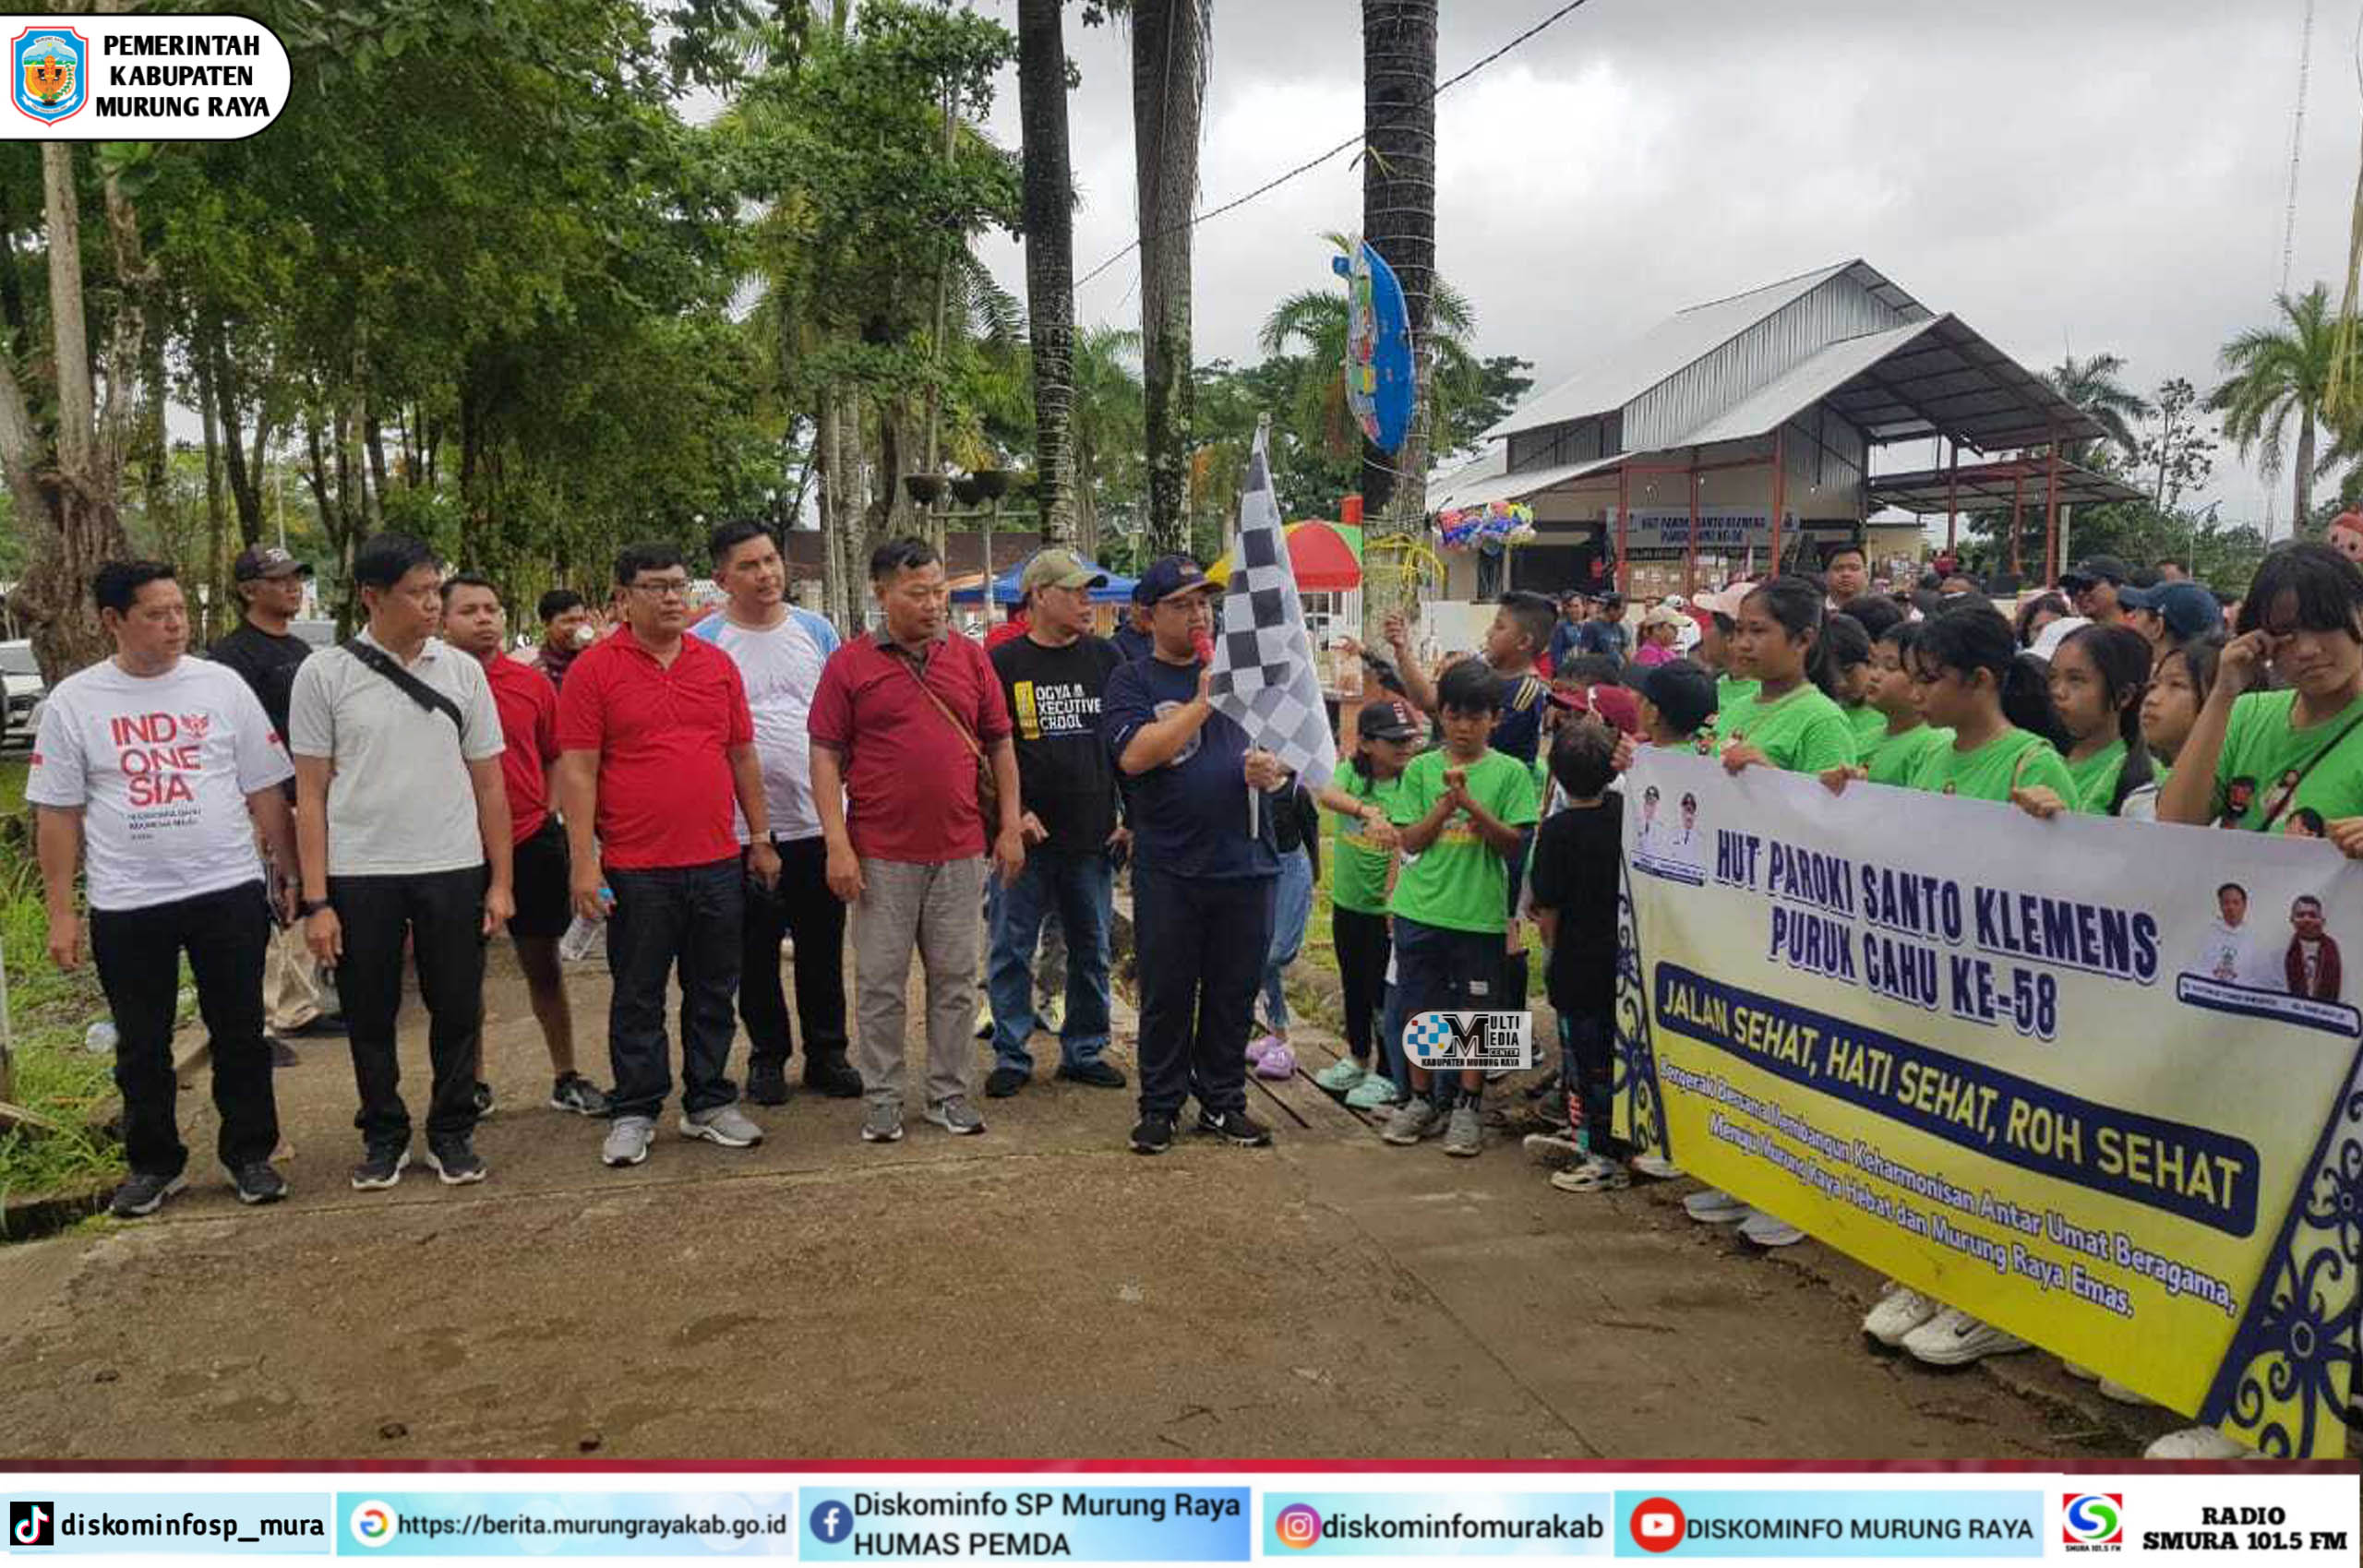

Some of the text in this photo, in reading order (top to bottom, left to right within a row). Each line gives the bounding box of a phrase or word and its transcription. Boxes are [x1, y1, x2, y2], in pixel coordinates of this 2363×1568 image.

[1035, 684, 1072, 700] OGYA
[1037, 697, 1102, 716] XECUTIVE
[110, 712, 177, 747] IND
[1039, 713, 1084, 731] CHOOL
[120, 745, 201, 777] ONE
[128, 773, 195, 808] SIA
[1715, 829, 2158, 981] HUT PAROKI SANTO KLEMENS
[1769, 905, 2057, 1037] PURUK CAHU KE-58
[1662, 979, 2243, 1210] JALAN SEHAT, HATI SEHAT, ROH SEHAT
[1853, 1140, 1975, 1212] Keharmonisan
[1980, 1191, 2043, 1236] Antar
[2045, 1211, 2110, 1259] Umat
[2114, 1232, 2237, 1318] Beragama,
[1896, 1200, 1929, 1237] dan
[1930, 1213, 2008, 1275] Murung
[2010, 1243, 2066, 1291] Raya
[2070, 1262, 2134, 1318] Emas.
